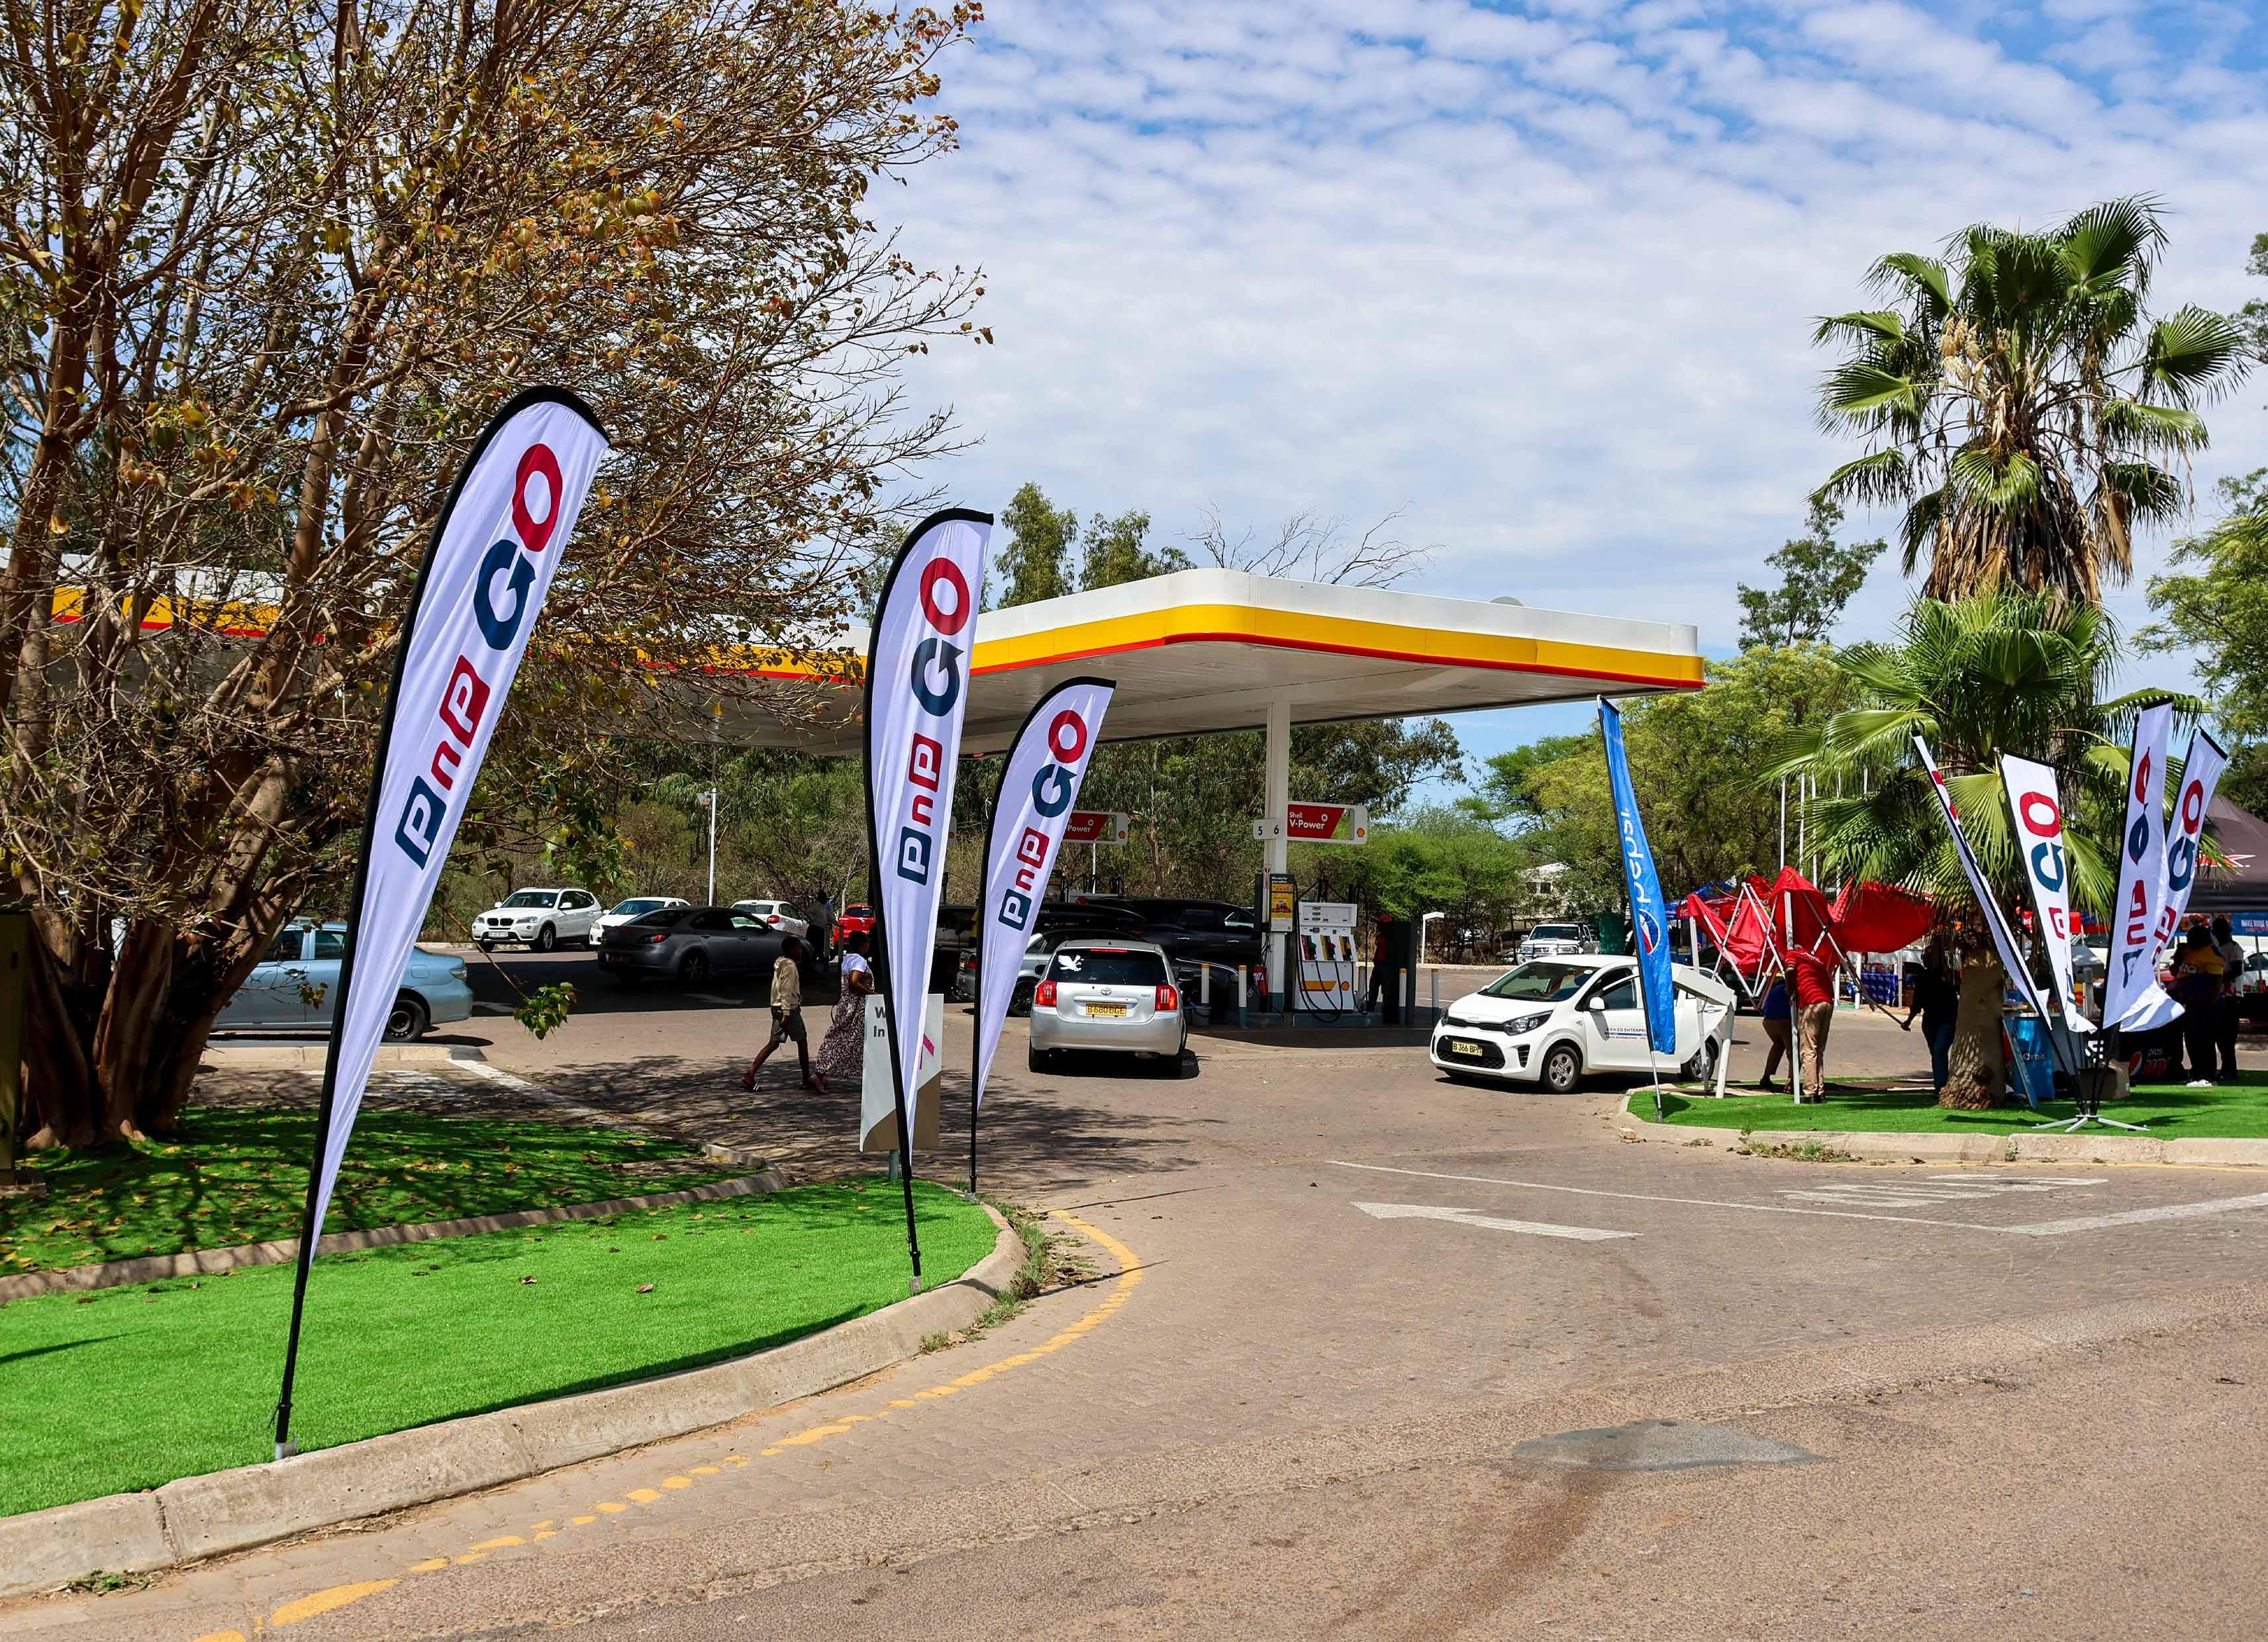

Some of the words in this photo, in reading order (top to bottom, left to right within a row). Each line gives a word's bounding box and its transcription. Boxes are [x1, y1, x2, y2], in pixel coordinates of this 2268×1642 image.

[395, 655, 490, 870] PnP
[473, 443, 563, 651] GO
[911, 557, 970, 717] GO
[897, 732, 943, 886] PnP
[999, 826, 1050, 930] PnP
[1032, 709, 1087, 818] GO
[1067, 824, 1091, 832] Power
[1258, 826, 1263, 836] 5
[1274, 825, 1279, 834] 6
[1289, 819, 1325, 829] V-Power
[1620, 807, 1652, 903] pepsi
[2020, 791, 2064, 893] GO
[2169, 779, 2204, 892] GO
[873, 1026, 885, 1038] In
